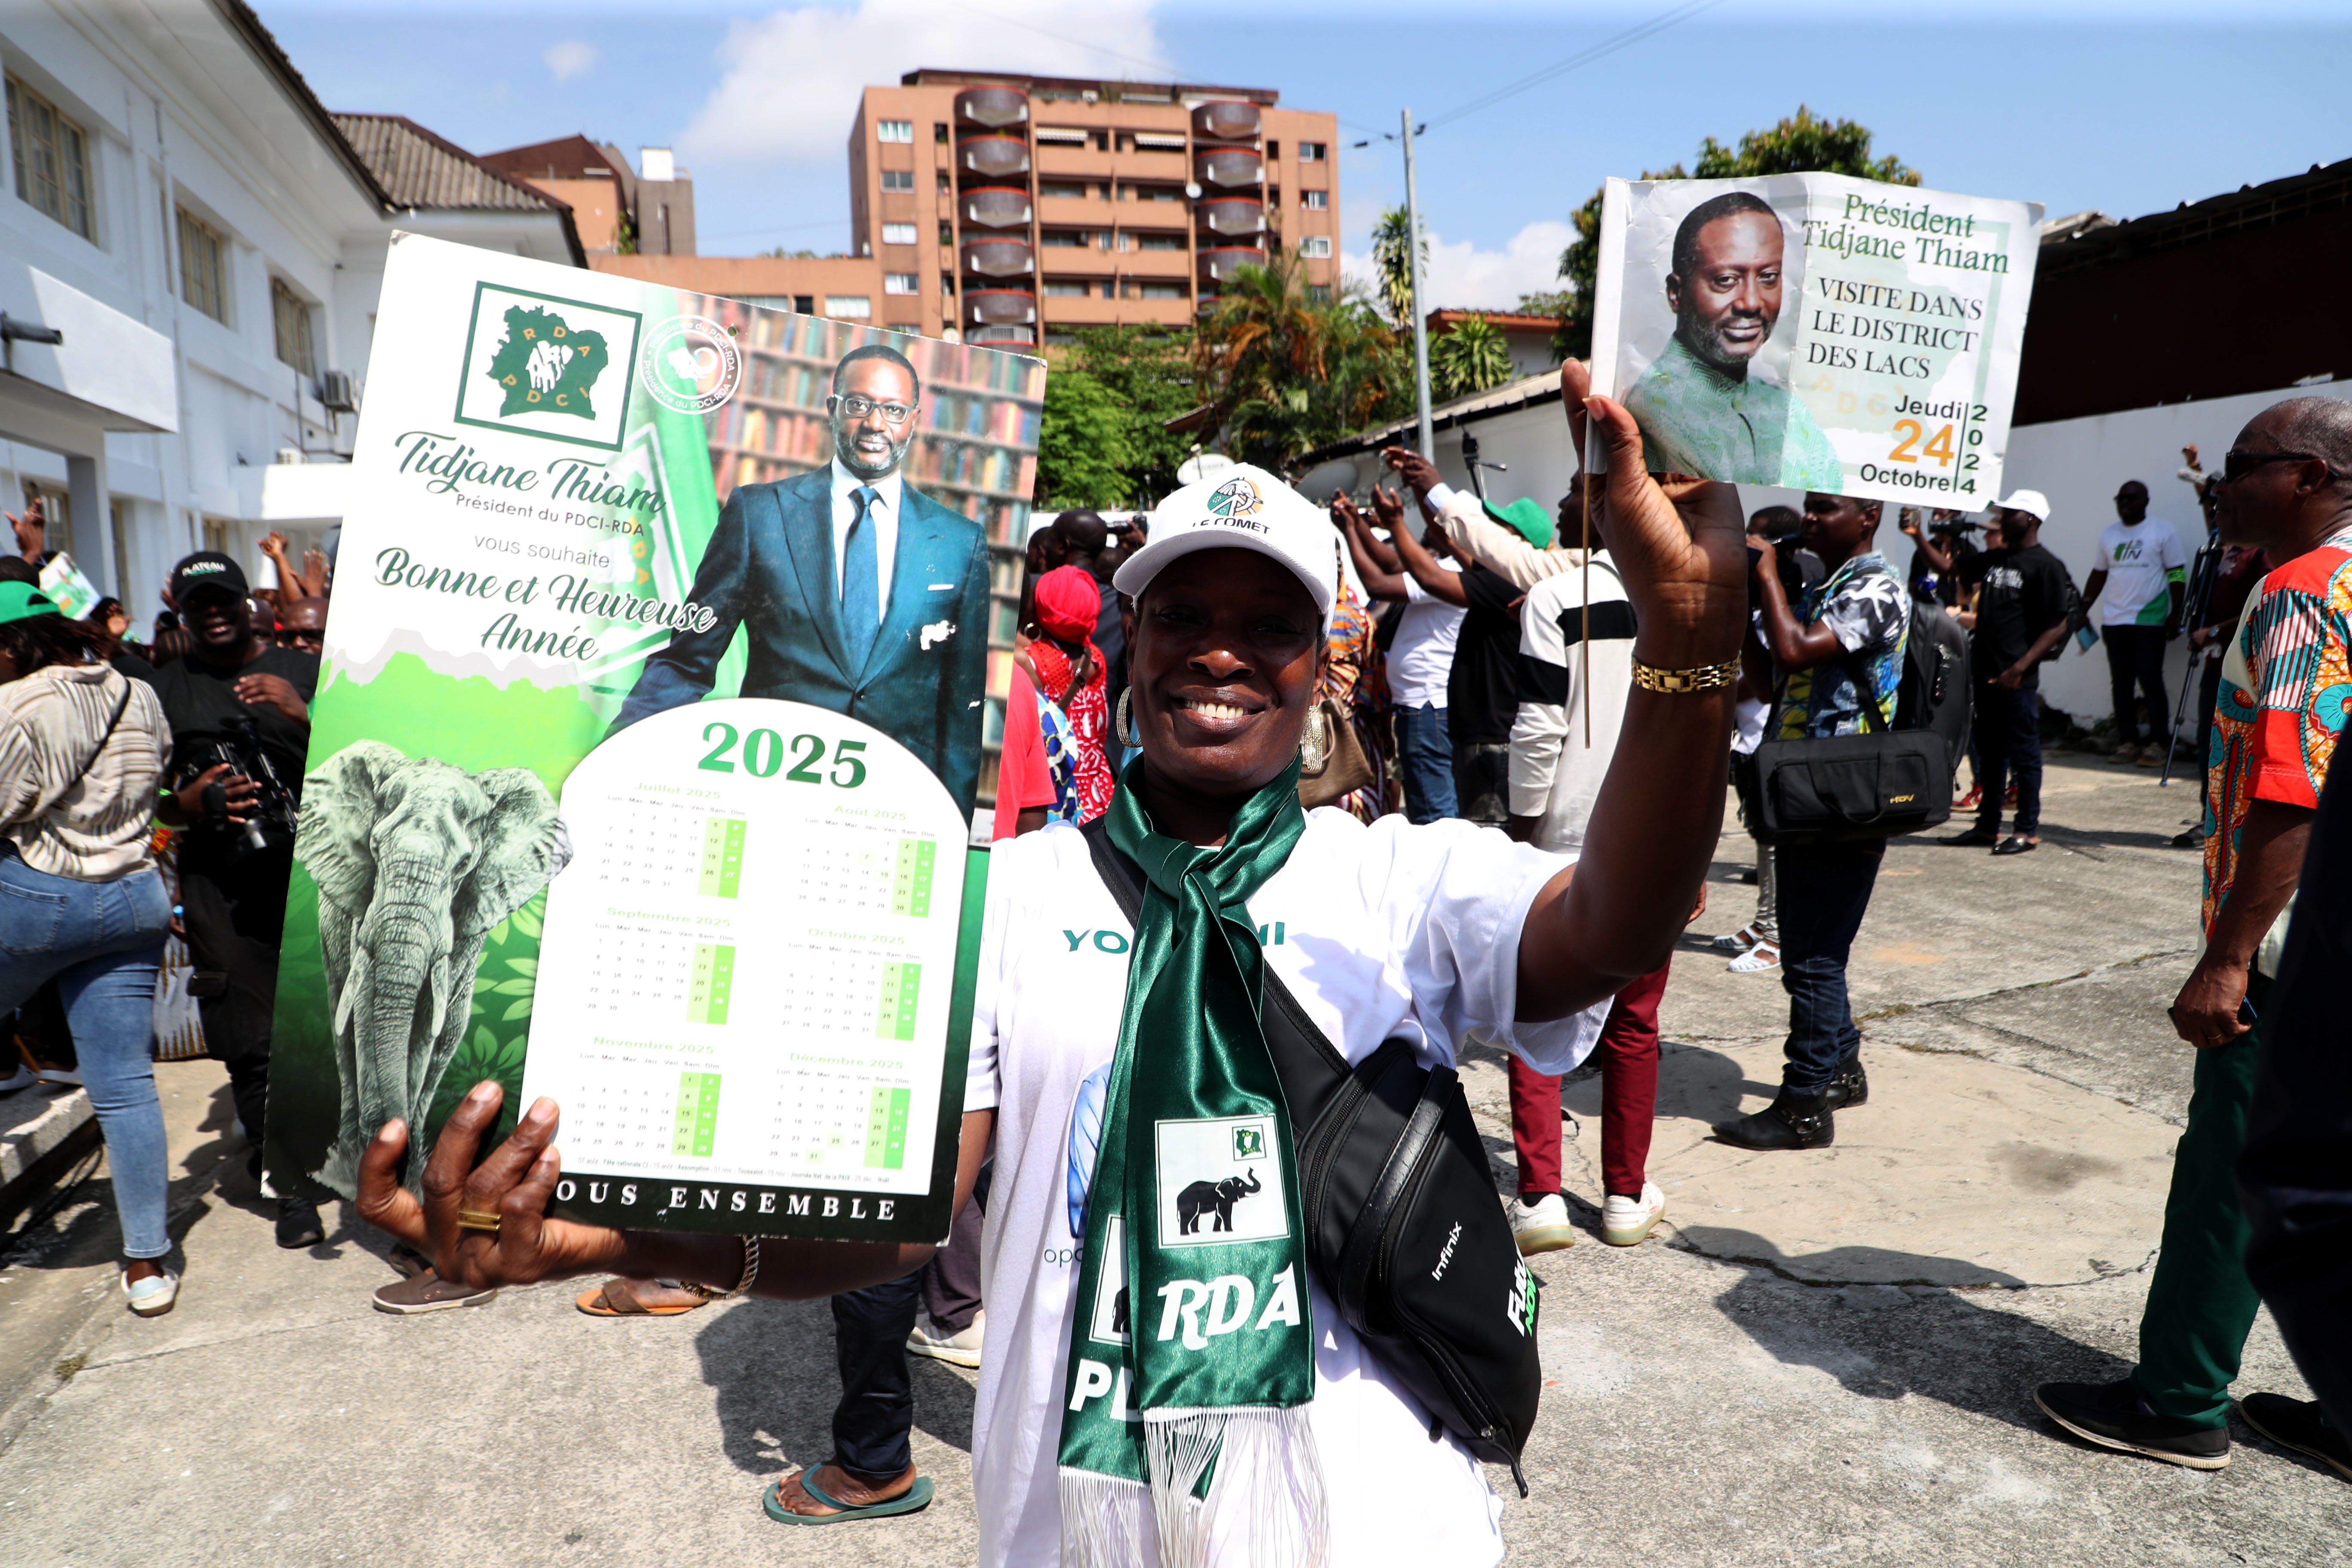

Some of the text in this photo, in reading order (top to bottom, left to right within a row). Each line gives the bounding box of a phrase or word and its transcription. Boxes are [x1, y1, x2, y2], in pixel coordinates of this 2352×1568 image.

[1842, 193, 1975, 239] Président
[1803, 219, 2010, 275] Tidjane Thiam
[1818, 276, 1983, 321] VISITE DANS
[1812, 310, 1978, 353] LE DISTRICT
[1807, 342, 1930, 380] DES LACS
[643, 360, 731, 409] Présidence du PDCI-RDA
[1894, 394, 1962, 420] Jeudi
[1889, 417, 1955, 468] 24
[395, 431, 667, 513] Tidjane Thiam
[1859, 464, 1951, 492] Octobre
[456, 493, 646, 537] Président du PDCI-RDA
[474, 535, 609, 569] vous souhaite
[375, 546, 717, 633] Bonne et Heureuse
[481, 612, 599, 660] Année
[698, 722, 867, 788] 2025
[634, 782, 721, 799] Juillet 2025
[834, 805, 906, 821] Août 2025
[607, 907, 730, 928] Septembre 2025
[808, 928, 905, 945] Octobre 2025
[593, 1036, 714, 1054] Novembre 2025
[789, 1052, 903, 1069] Décembre 2025
[556, 1179, 895, 1220] OUS ENSEMBLE
[1431, 1221, 1462, 1281] Infinix
[1157, 1261, 1300, 1351] RDA
